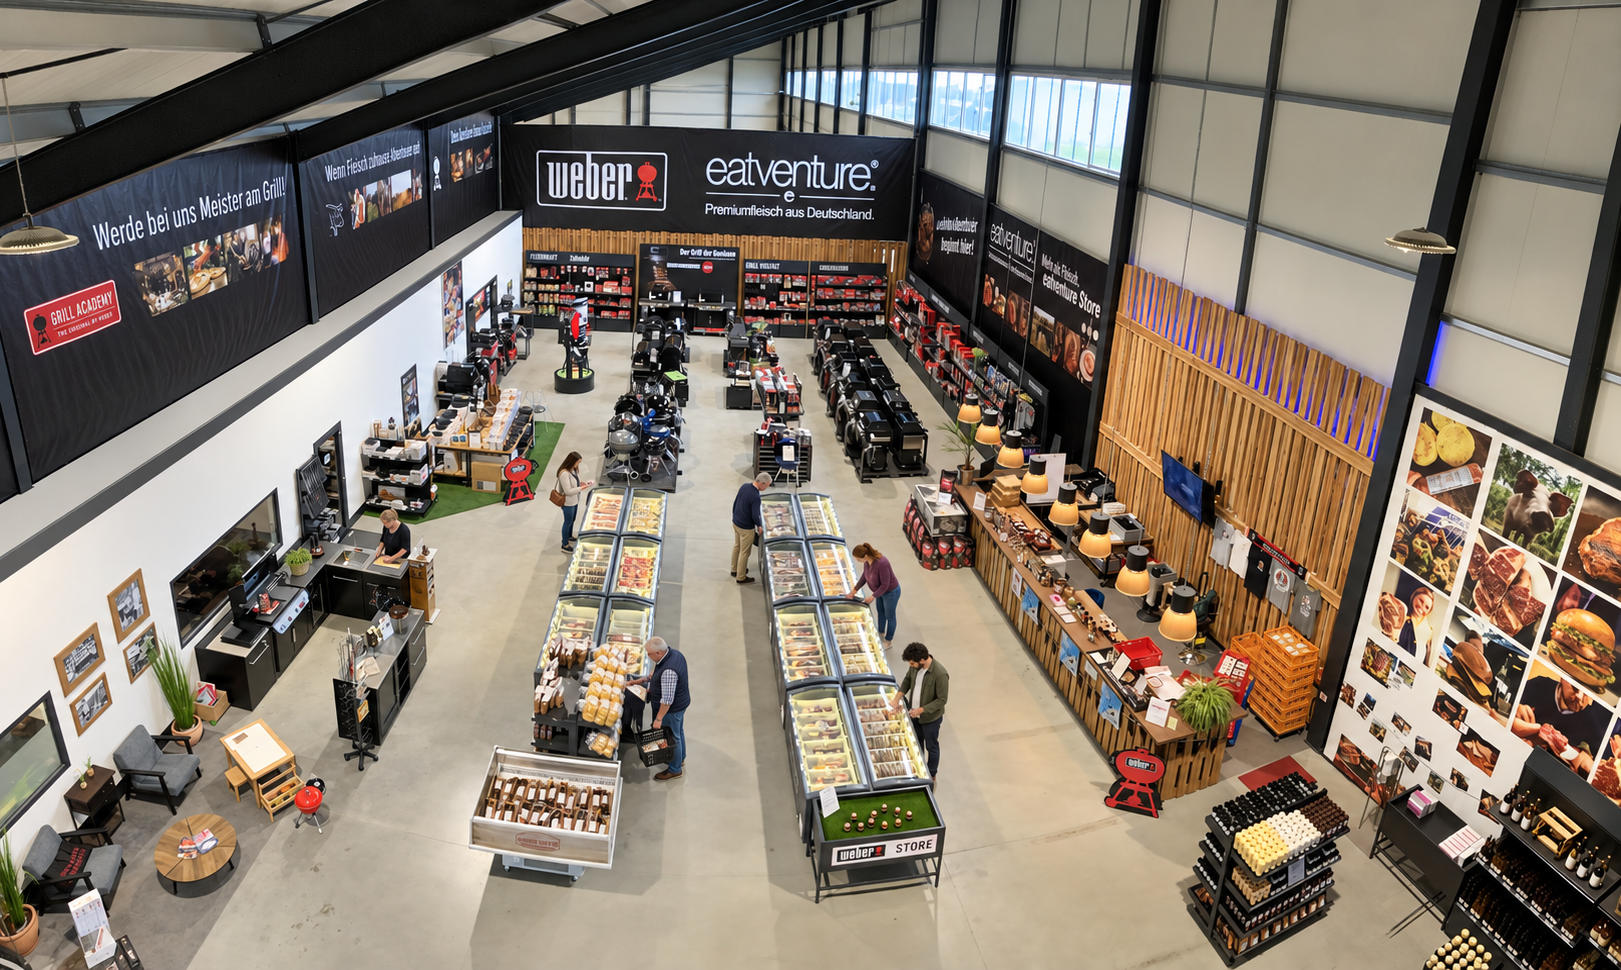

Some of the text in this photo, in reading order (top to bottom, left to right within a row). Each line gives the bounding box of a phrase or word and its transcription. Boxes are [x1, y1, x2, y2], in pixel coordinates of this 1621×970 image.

[324, 164, 346, 182] Wenn
[546, 152, 632, 201] weber
[92, 176, 286, 250] Werde bei uns Meister am Grill!
[705, 203, 874, 220] Premiumfleisch aus Deutschland.
[50, 290, 113, 326] GRILL ACADEMY
[1079, 290, 1100, 318] Store
[840, 839, 933, 861] weber STORE
